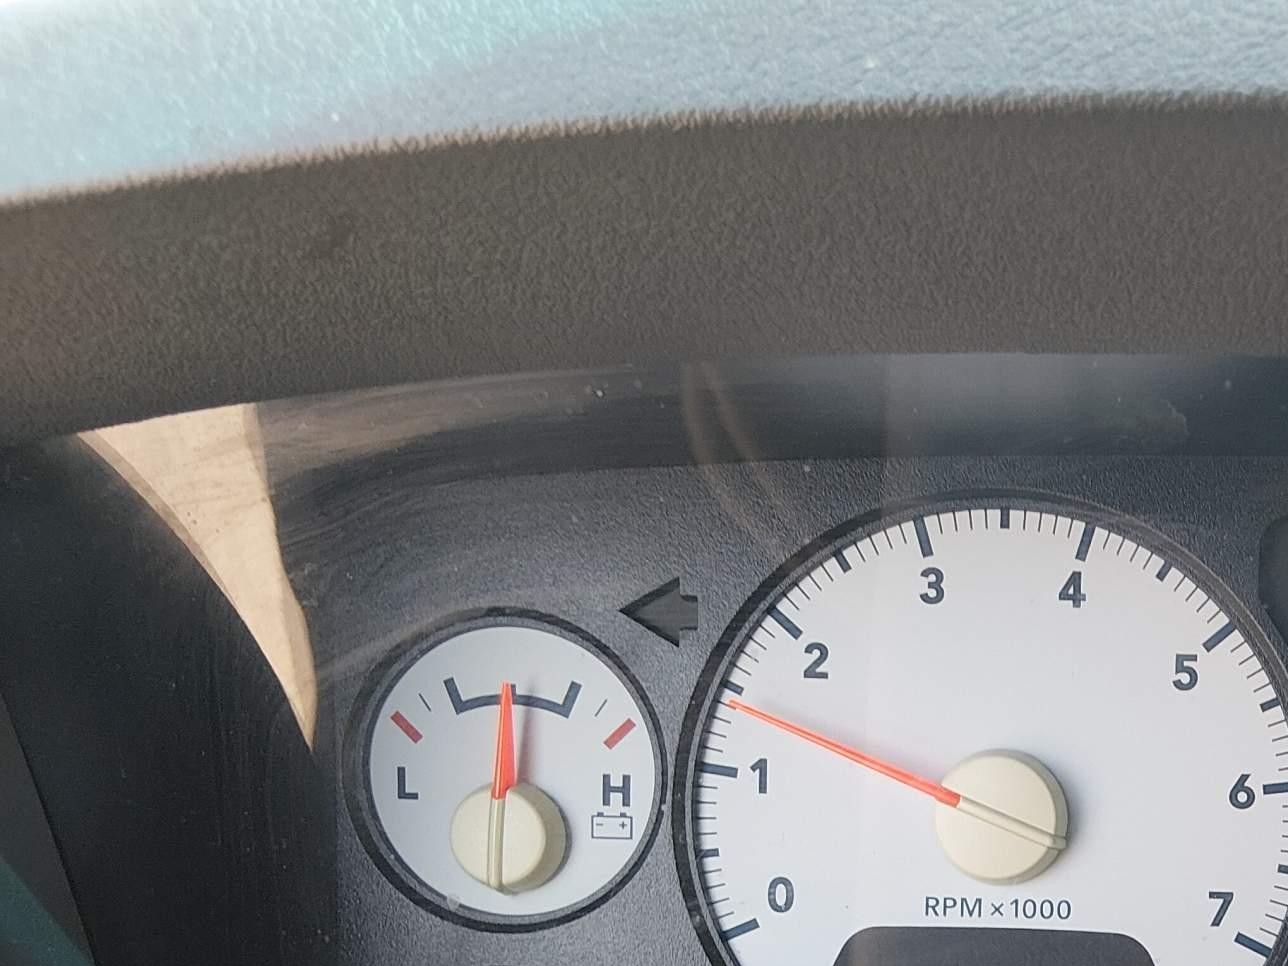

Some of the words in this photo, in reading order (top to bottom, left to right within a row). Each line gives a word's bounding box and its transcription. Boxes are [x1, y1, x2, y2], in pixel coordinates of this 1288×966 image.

[919, 566, 945, 605] 3
[1058, 570, 1087, 609] 4
[803, 642, 829, 680] 2
[1172, 653, 1199, 691] 5
[396, 766, 419, 801] L
[602, 773, 631, 808] H
[749, 758, 768, 795] 1
[1228, 773, 1256, 810] 6
[767, 876, 795, 913] 0
[925, 896, 983, 918] RPM
[1208, 891, 1234, 927] 7
